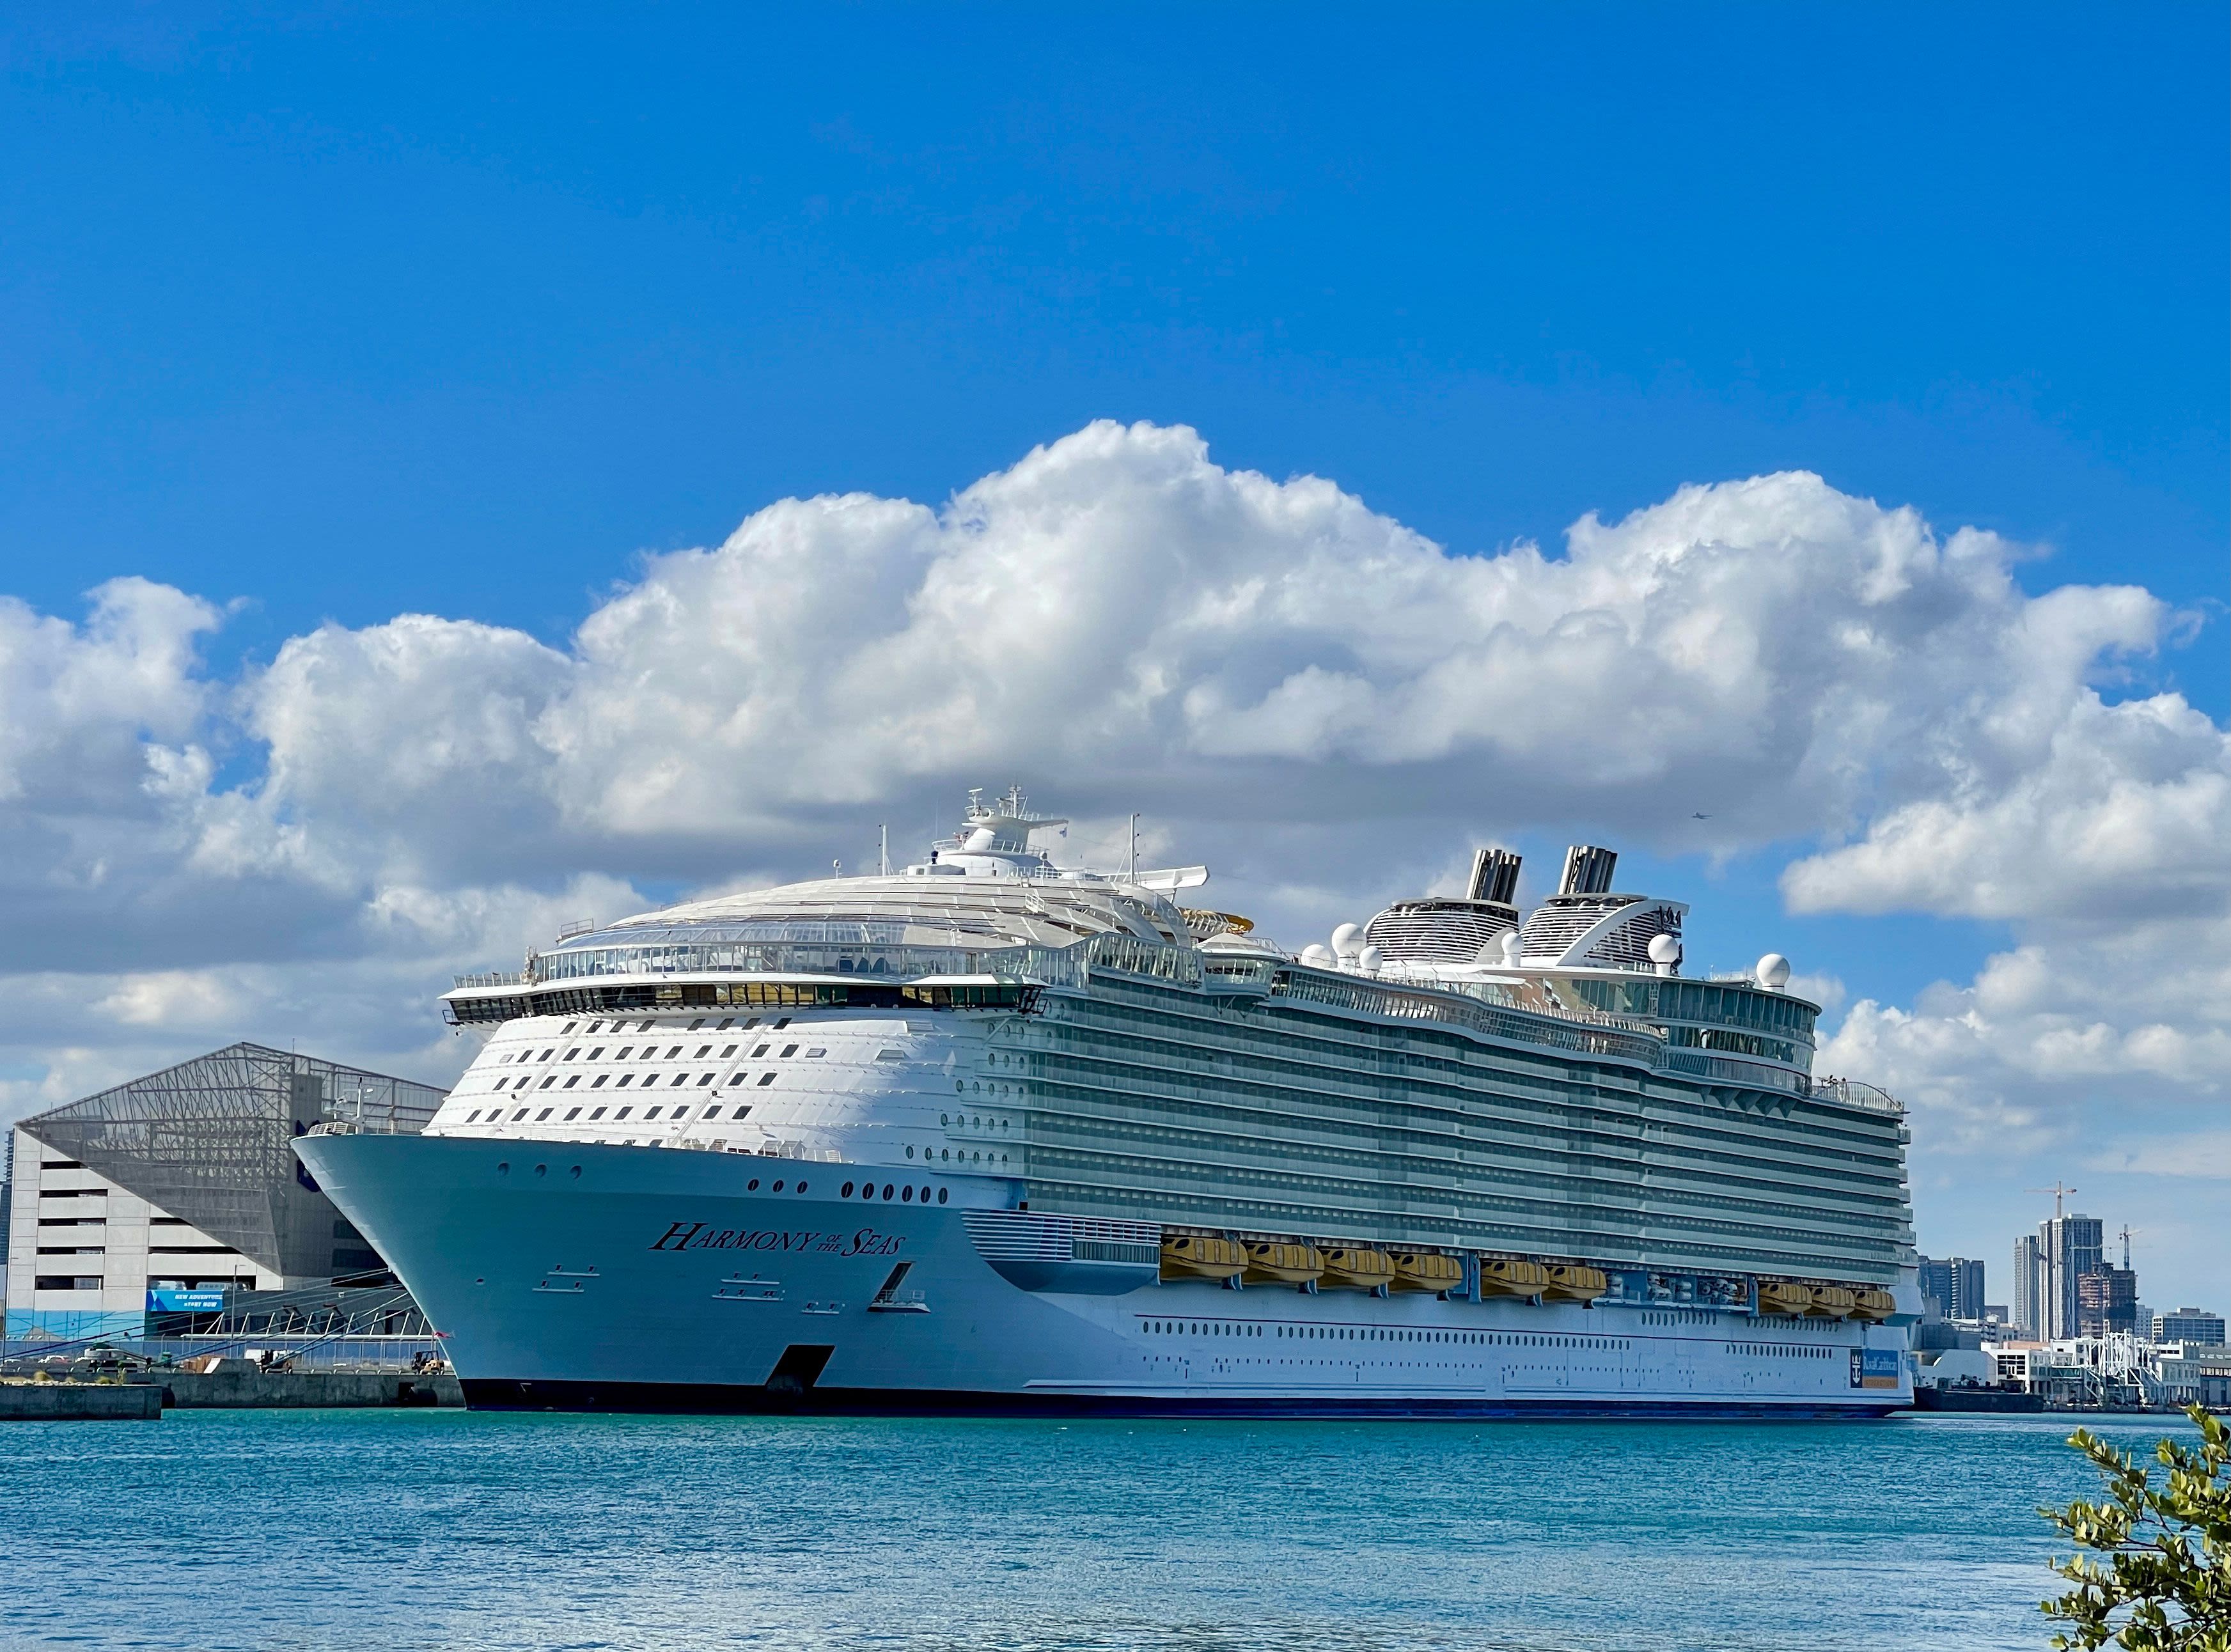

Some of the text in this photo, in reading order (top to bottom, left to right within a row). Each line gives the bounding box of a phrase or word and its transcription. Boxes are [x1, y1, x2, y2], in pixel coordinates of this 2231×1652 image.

[647, 1222, 906, 1257] HARMONY OF THE SEAS
